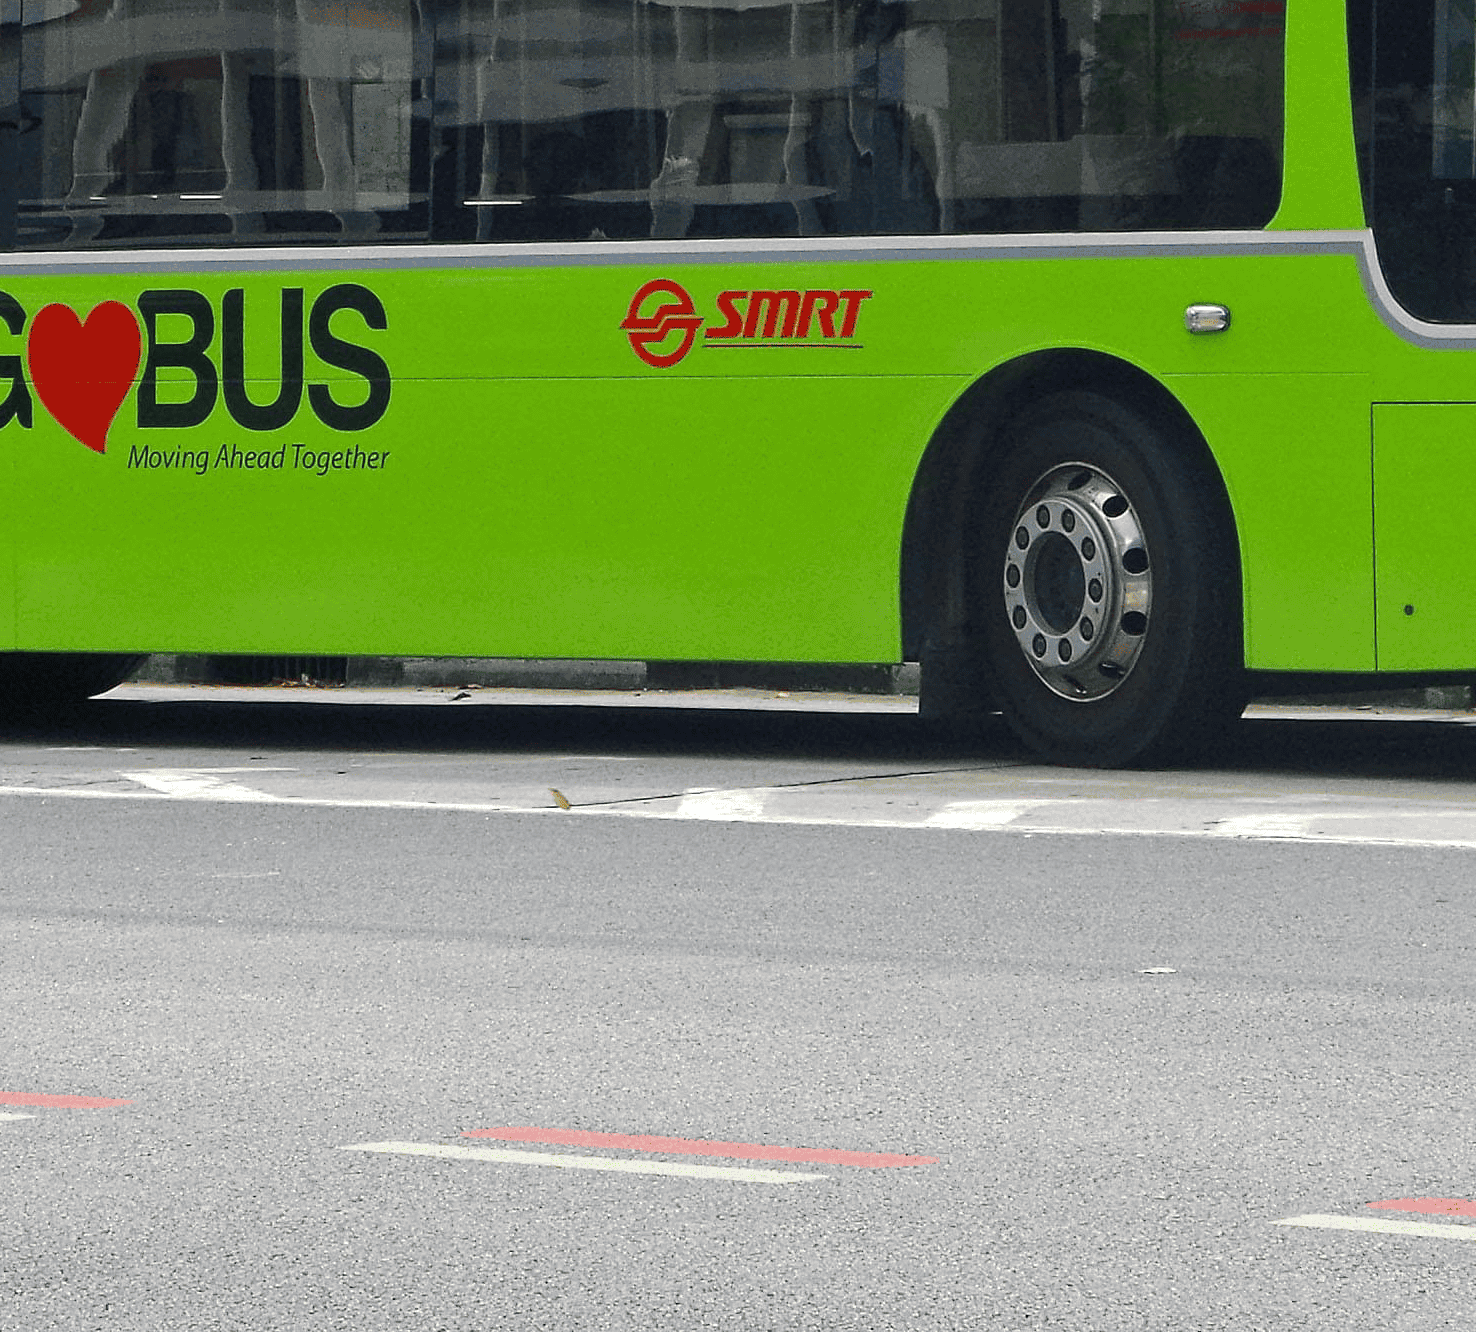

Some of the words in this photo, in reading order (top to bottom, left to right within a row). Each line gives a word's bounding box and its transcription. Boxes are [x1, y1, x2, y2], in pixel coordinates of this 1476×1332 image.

[705, 289, 874, 339] SMRT
[127, 444, 209, 475] Moving
[214, 443, 286, 469] Ahead
[291, 443, 390, 476] Together
